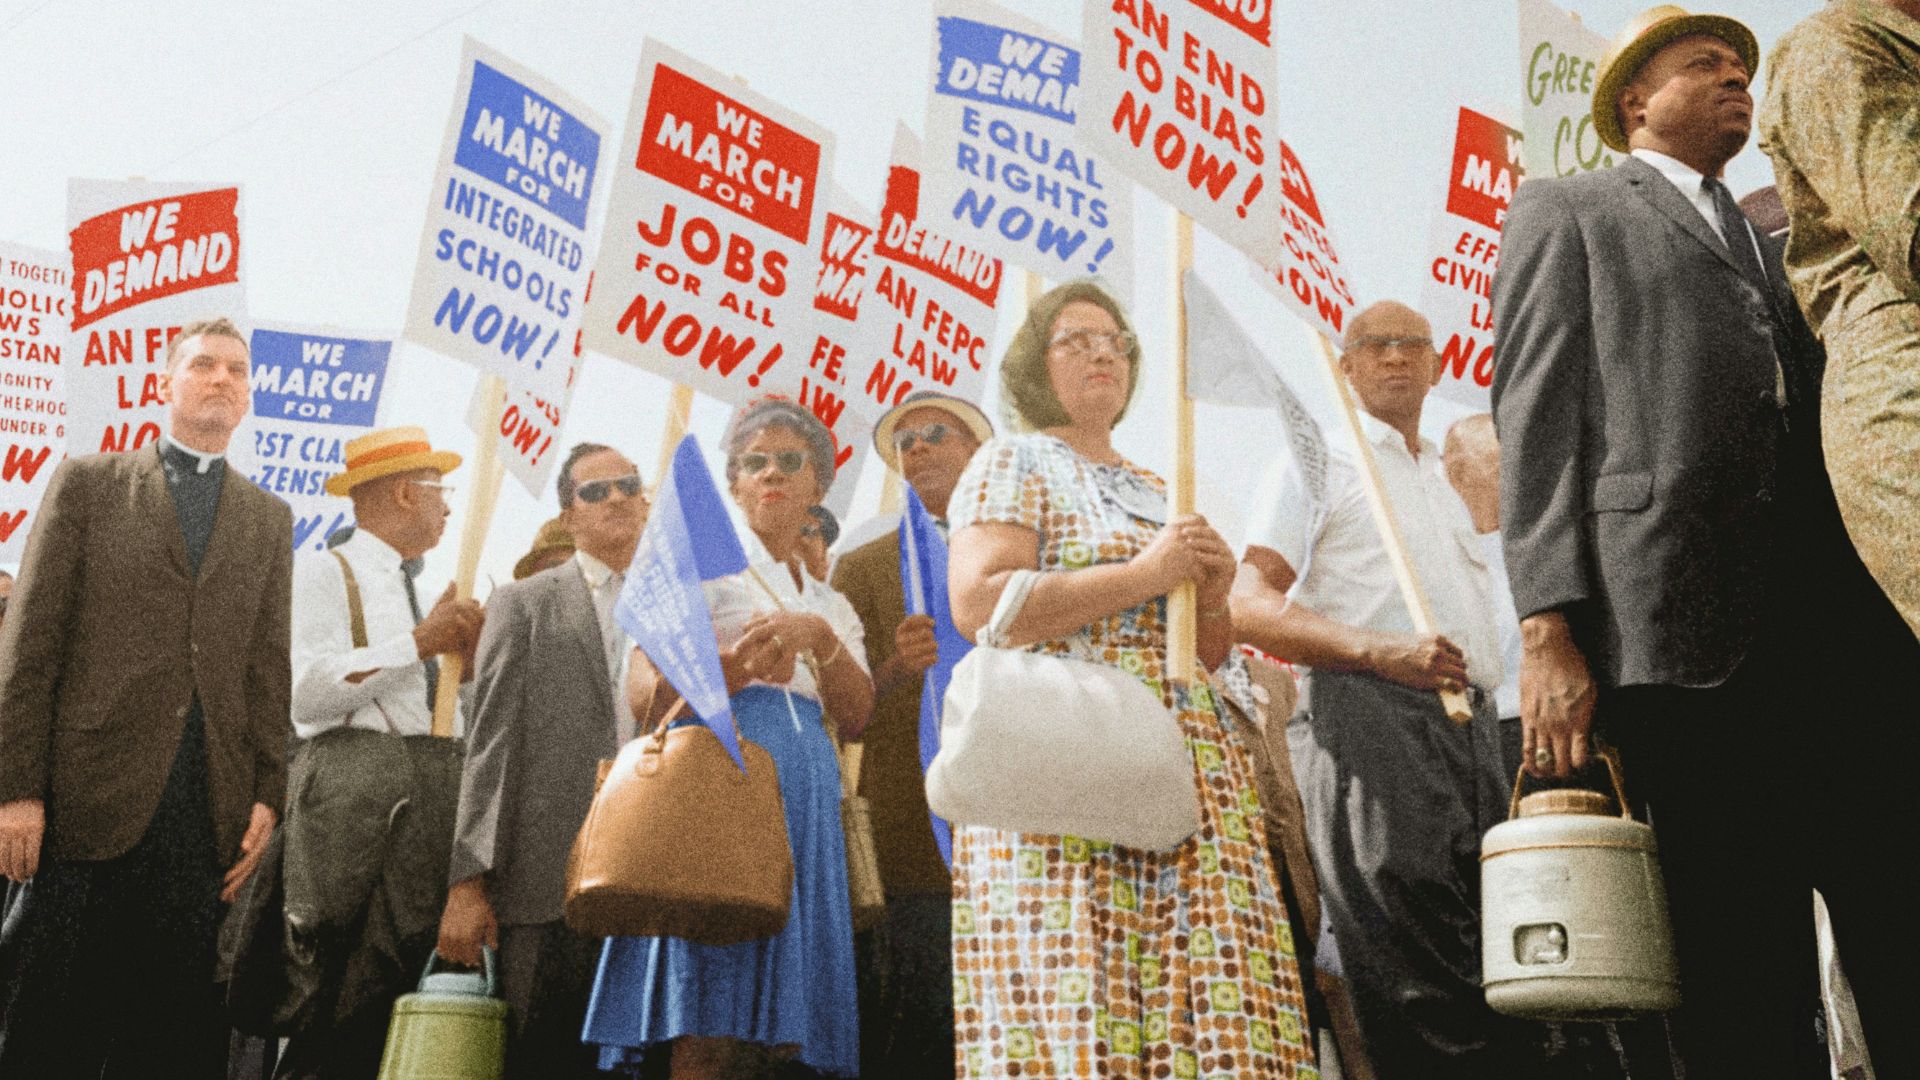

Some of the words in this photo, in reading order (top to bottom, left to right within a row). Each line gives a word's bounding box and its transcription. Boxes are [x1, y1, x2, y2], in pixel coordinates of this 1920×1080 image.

[998, 33, 1069, 76] WE
[1112, 0, 1169, 52] AN
[1184, 31, 1265, 117] END
[1526, 41, 1596, 107] GREE
[523, 95, 563, 142] WE
[716, 101, 764, 149] WE
[1114, 27, 1163, 94] TO
[1175, 75, 1265, 167] BIAS
[472, 107, 587, 199] MARCH
[504, 167, 552, 205] FOR
[655, 112, 803, 209] MARCH
[957, 141, 1109, 229] RIGHTS
[962, 106, 1103, 190] EQUAL
[1112, 90, 1264, 219] NOW!
[120, 202, 181, 253] WE
[444, 177, 582, 272] INTEGRATED
[699, 173, 755, 214] FOR
[952, 187, 1115, 274] NOW!
[81, 231, 232, 314] DEMAND
[436, 228, 572, 319] SCHOOLS
[637, 203, 788, 297] JOBS
[885, 212, 996, 289] DEMAND
[1455, 231, 1501, 268] EFF
[635, 252, 701, 296] FOR
[719, 291, 775, 328] ALL
[875, 265, 917, 320] AN
[923, 299, 986, 371] FEPC
[83, 329, 133, 366] AN
[302, 341, 345, 367] WE
[434, 287, 560, 370] NOW!
[616, 293, 783, 388] NOW!
[892, 322, 958, 387] LAW
[252, 364, 377, 402] MARCH
[283, 401, 333, 418] FOR
[0, 417, 47, 436] UNDER
[300, 436, 346, 463] CLA
